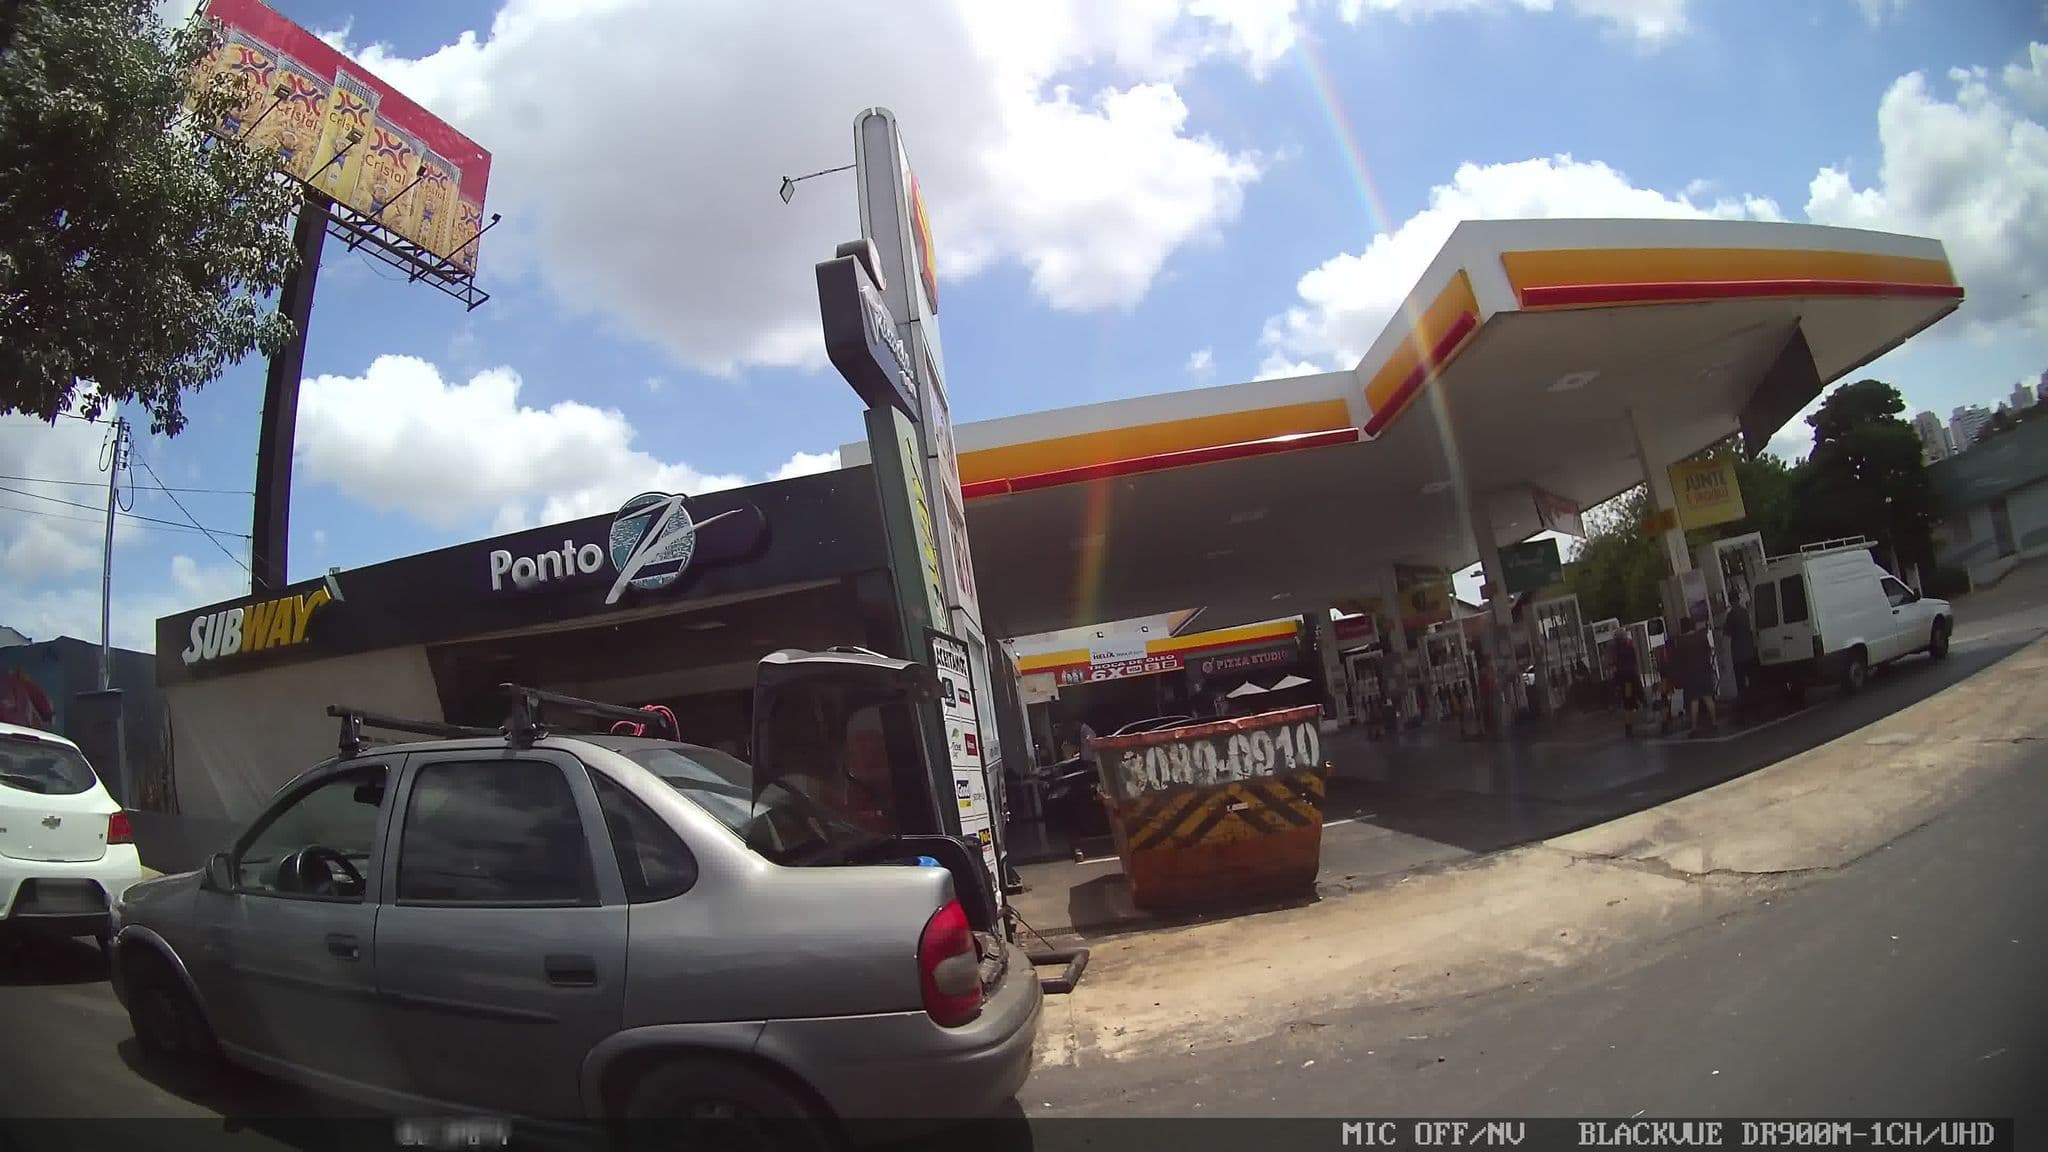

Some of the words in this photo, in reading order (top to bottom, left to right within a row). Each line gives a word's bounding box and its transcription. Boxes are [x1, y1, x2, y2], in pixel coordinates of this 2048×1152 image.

[365, 154, 407, 186] Cristal
[490, 539, 604, 591] Ponto
[181, 585, 331, 666] SUBWAY
[1088, 661, 1125, 671] TROCA
[1129, 658, 1144, 666] DE
[1091, 667, 1125, 681] 6X
[1216, 656, 1250, 670] PIZZA
